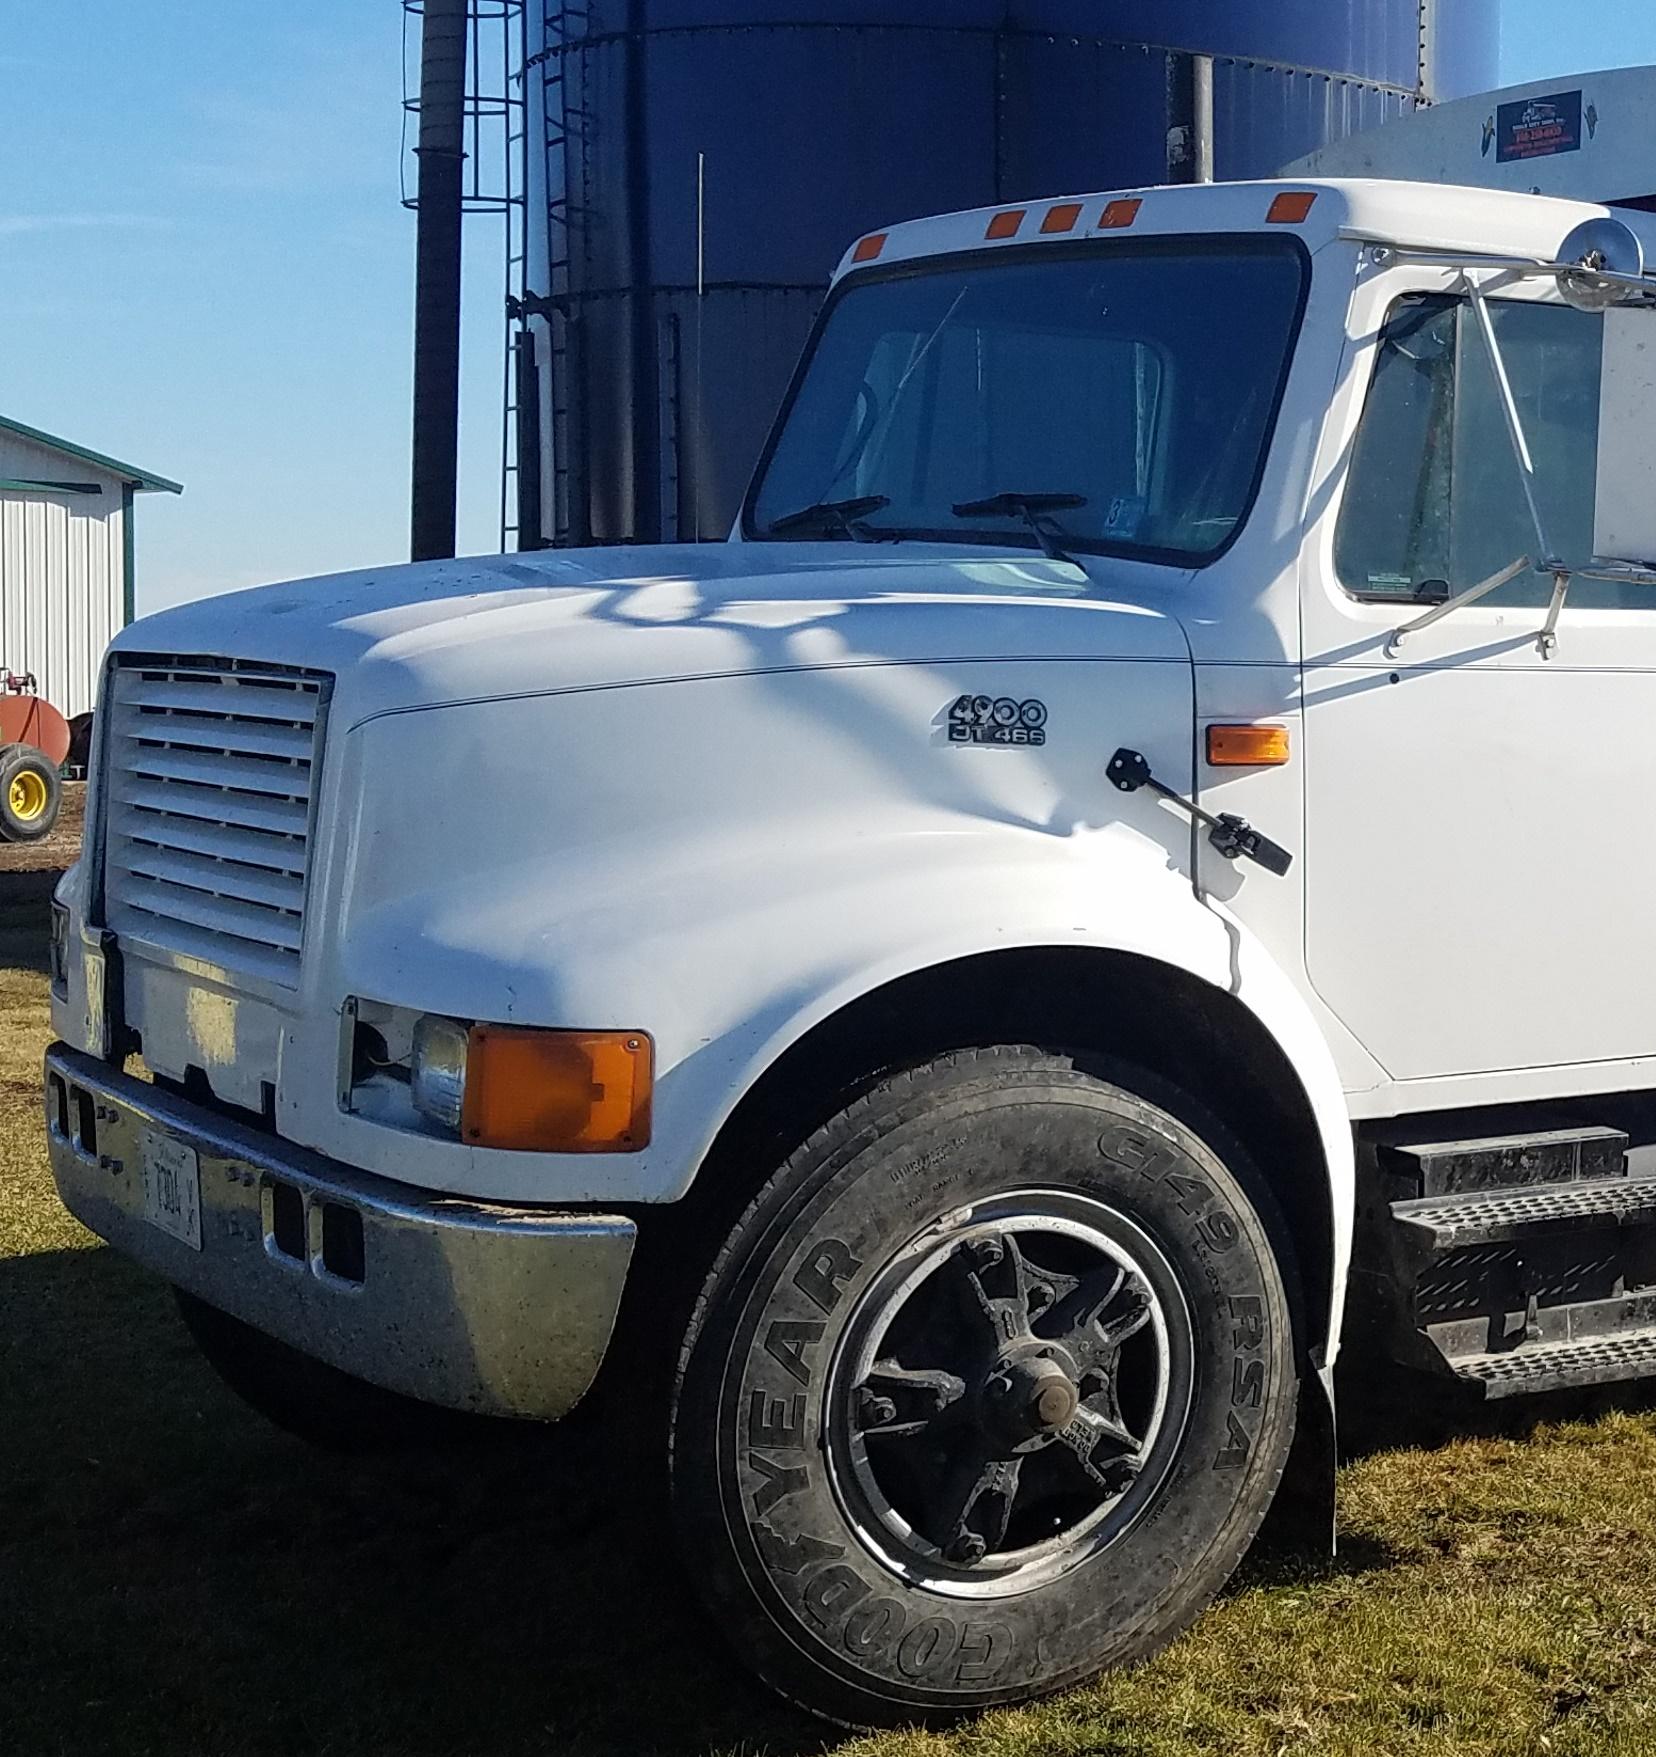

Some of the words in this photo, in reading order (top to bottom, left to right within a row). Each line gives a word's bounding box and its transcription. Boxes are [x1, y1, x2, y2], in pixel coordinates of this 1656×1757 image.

[948, 694, 1048, 728] 4900
[951, 725, 986, 742] DT
[995, 728, 1045, 744] 466
[1097, 1125, 1240, 1255] G149
[1212, 1294, 1266, 1471] RSA
[747, 1238, 1013, 1682] GOODYEAR
